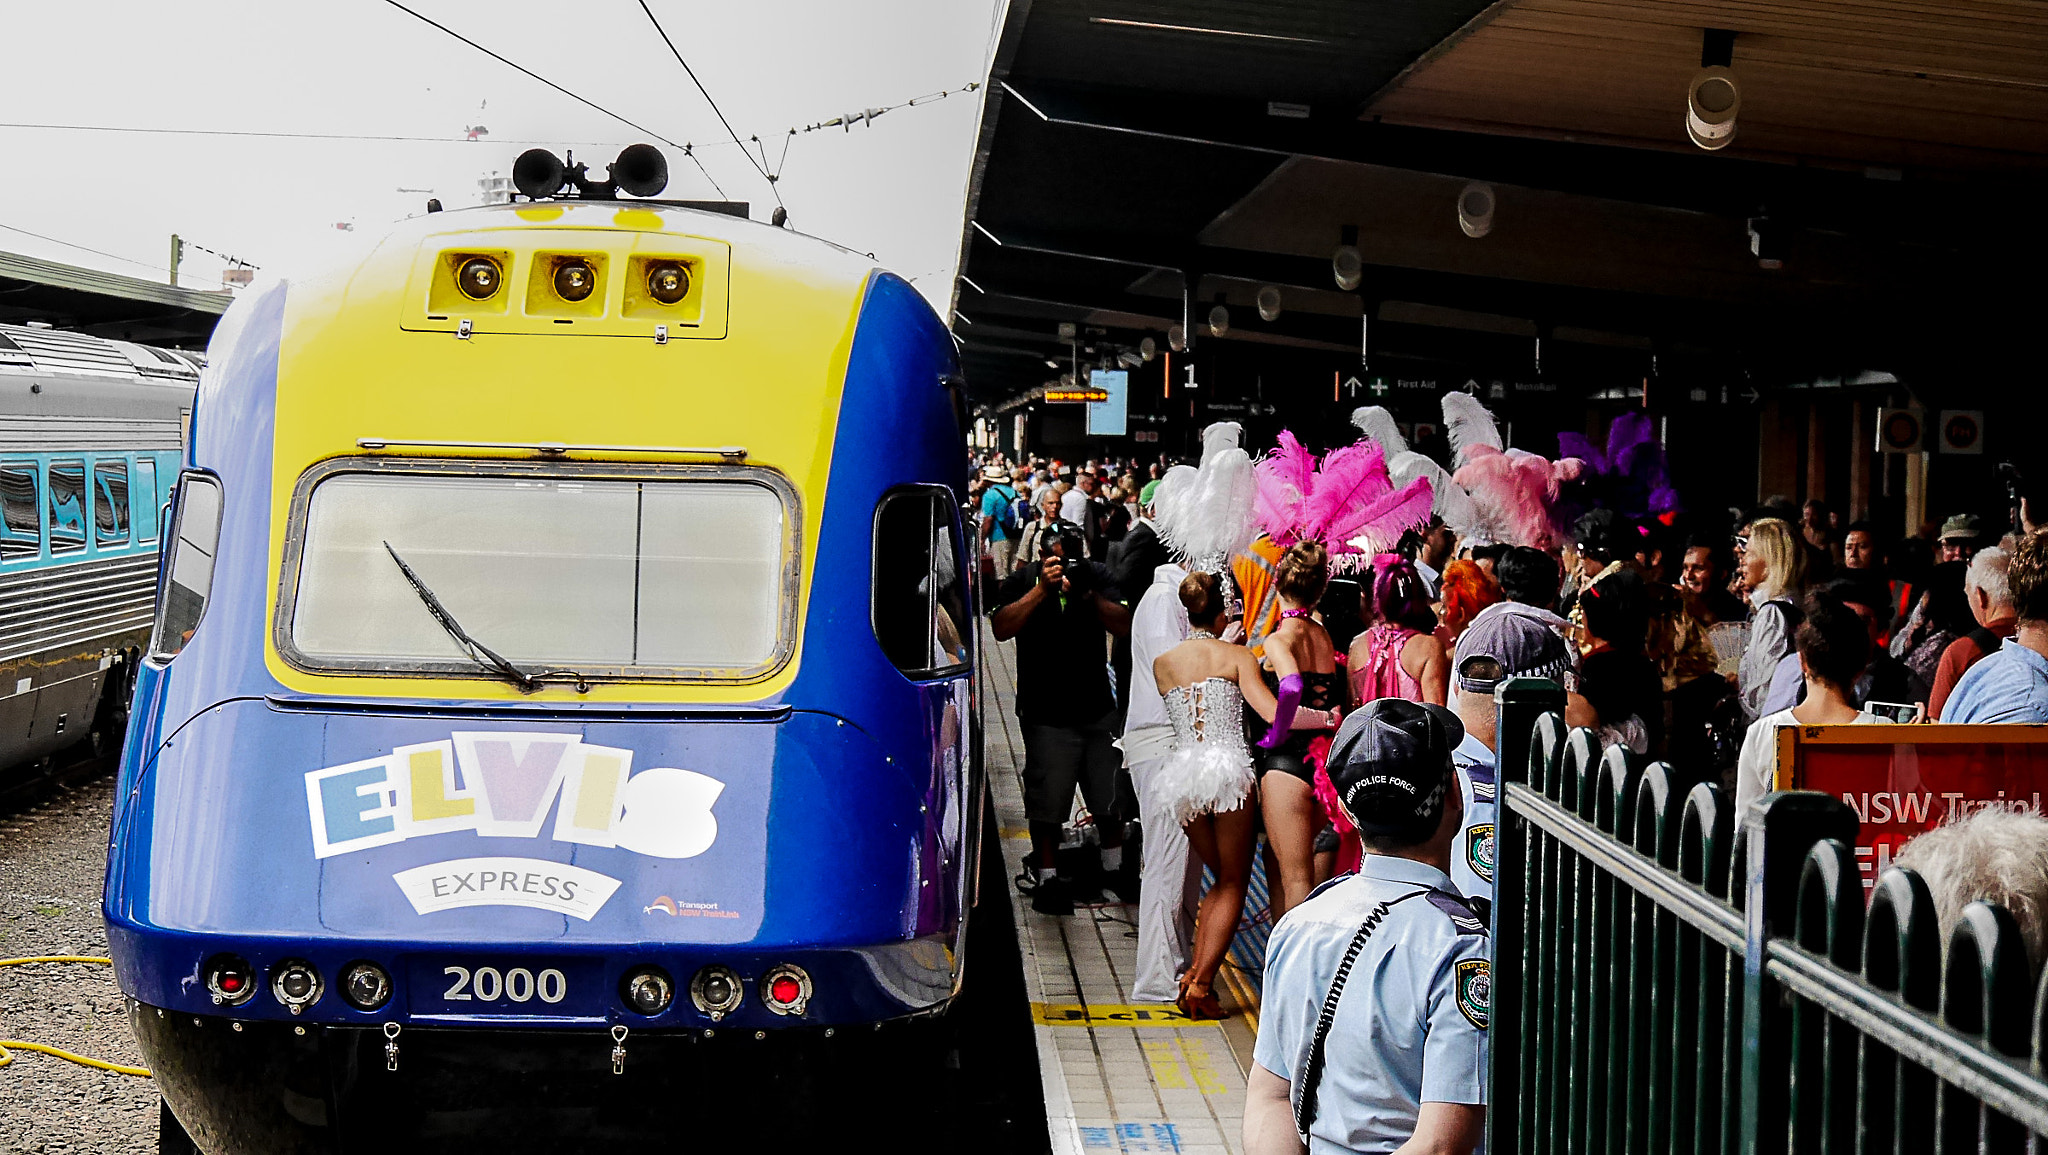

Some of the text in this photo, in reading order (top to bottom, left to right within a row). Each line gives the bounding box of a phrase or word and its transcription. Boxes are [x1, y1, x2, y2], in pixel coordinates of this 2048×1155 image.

[1184, 364, 1198, 388] 1
[1397, 379, 1436, 389] First Aid
[305, 731, 726, 859] ELVIS
[1356, 775, 1387, 790] POLICE
[1389, 776, 1417, 795] FORCE
[1842, 792, 1932, 823] NSW
[431, 871, 579, 901] EXPRESS
[678, 901, 718, 910] Transport
[679, 909, 739, 918] NSW TrainLink
[443, 966, 567, 1003] 2000
